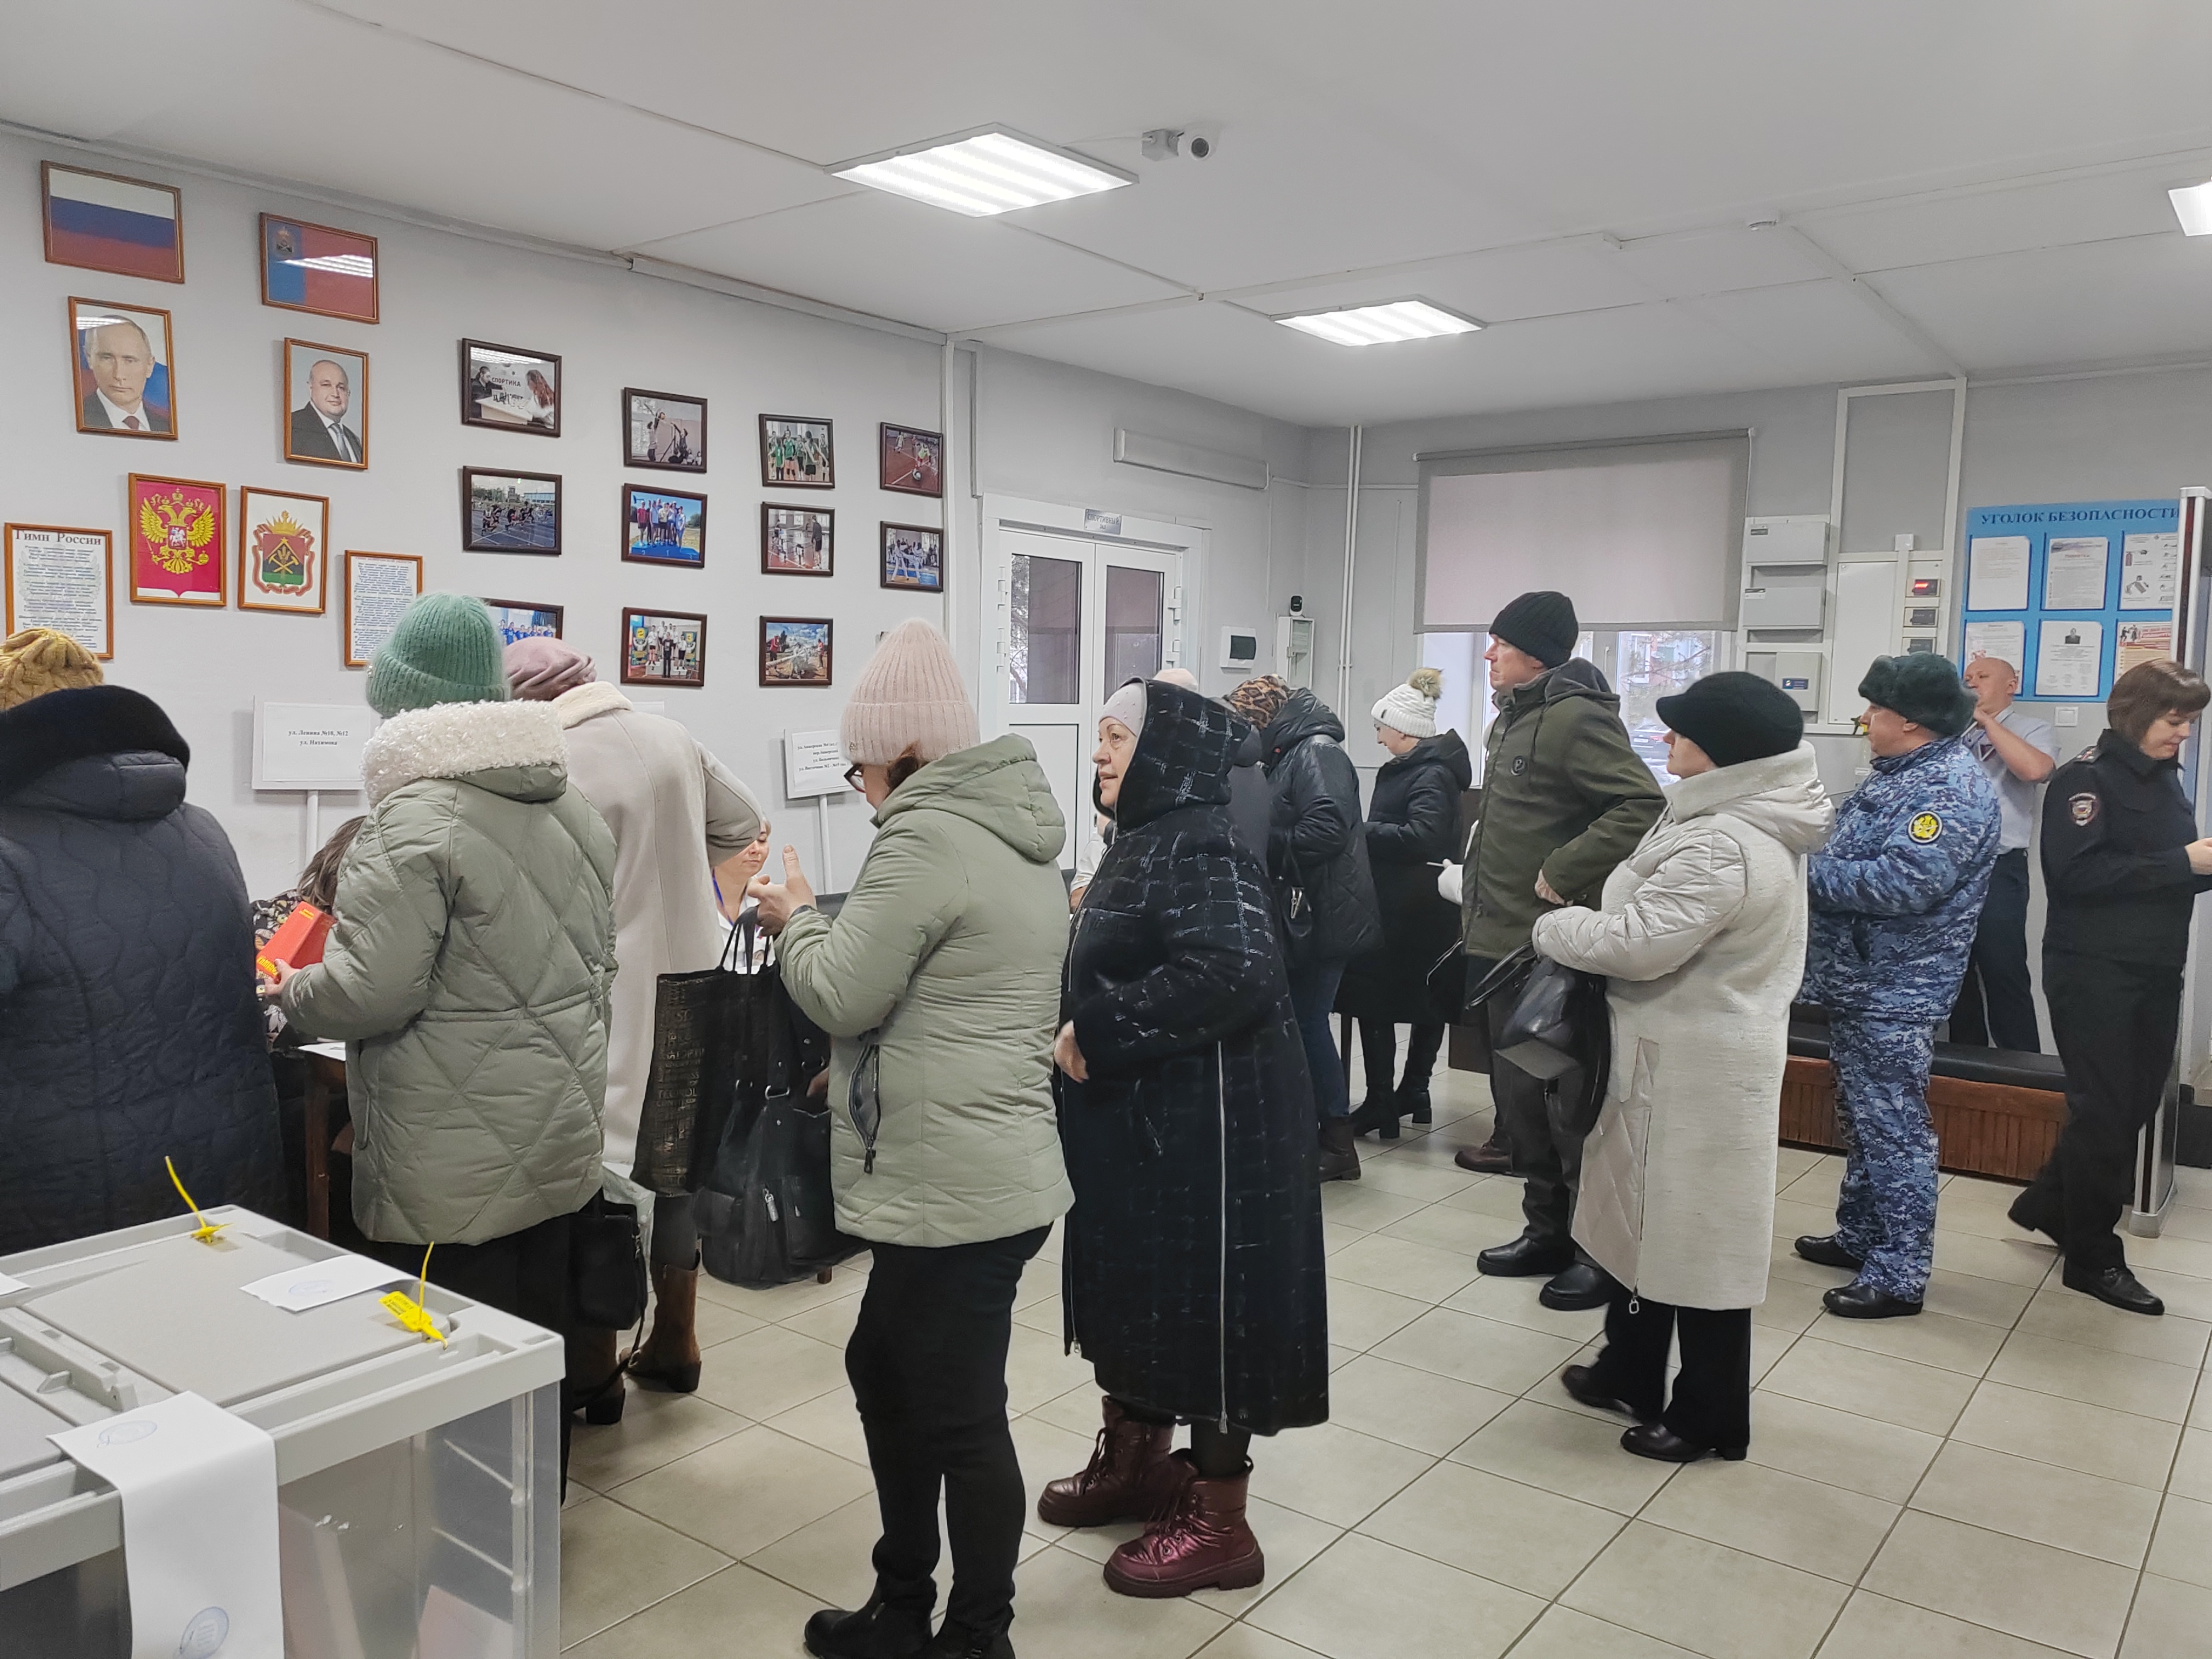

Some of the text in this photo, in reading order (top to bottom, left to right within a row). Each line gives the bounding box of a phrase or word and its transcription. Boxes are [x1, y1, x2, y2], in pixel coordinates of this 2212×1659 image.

[492, 377, 521, 387] СПОРТИКА
[1087, 514, 1119, 524] СПОРТИВНЫЙ
[1981, 508, 2179, 524] УГОЛОК БЕЗОПАСНОСТИ
[15, 530, 101, 545] Гимн России
